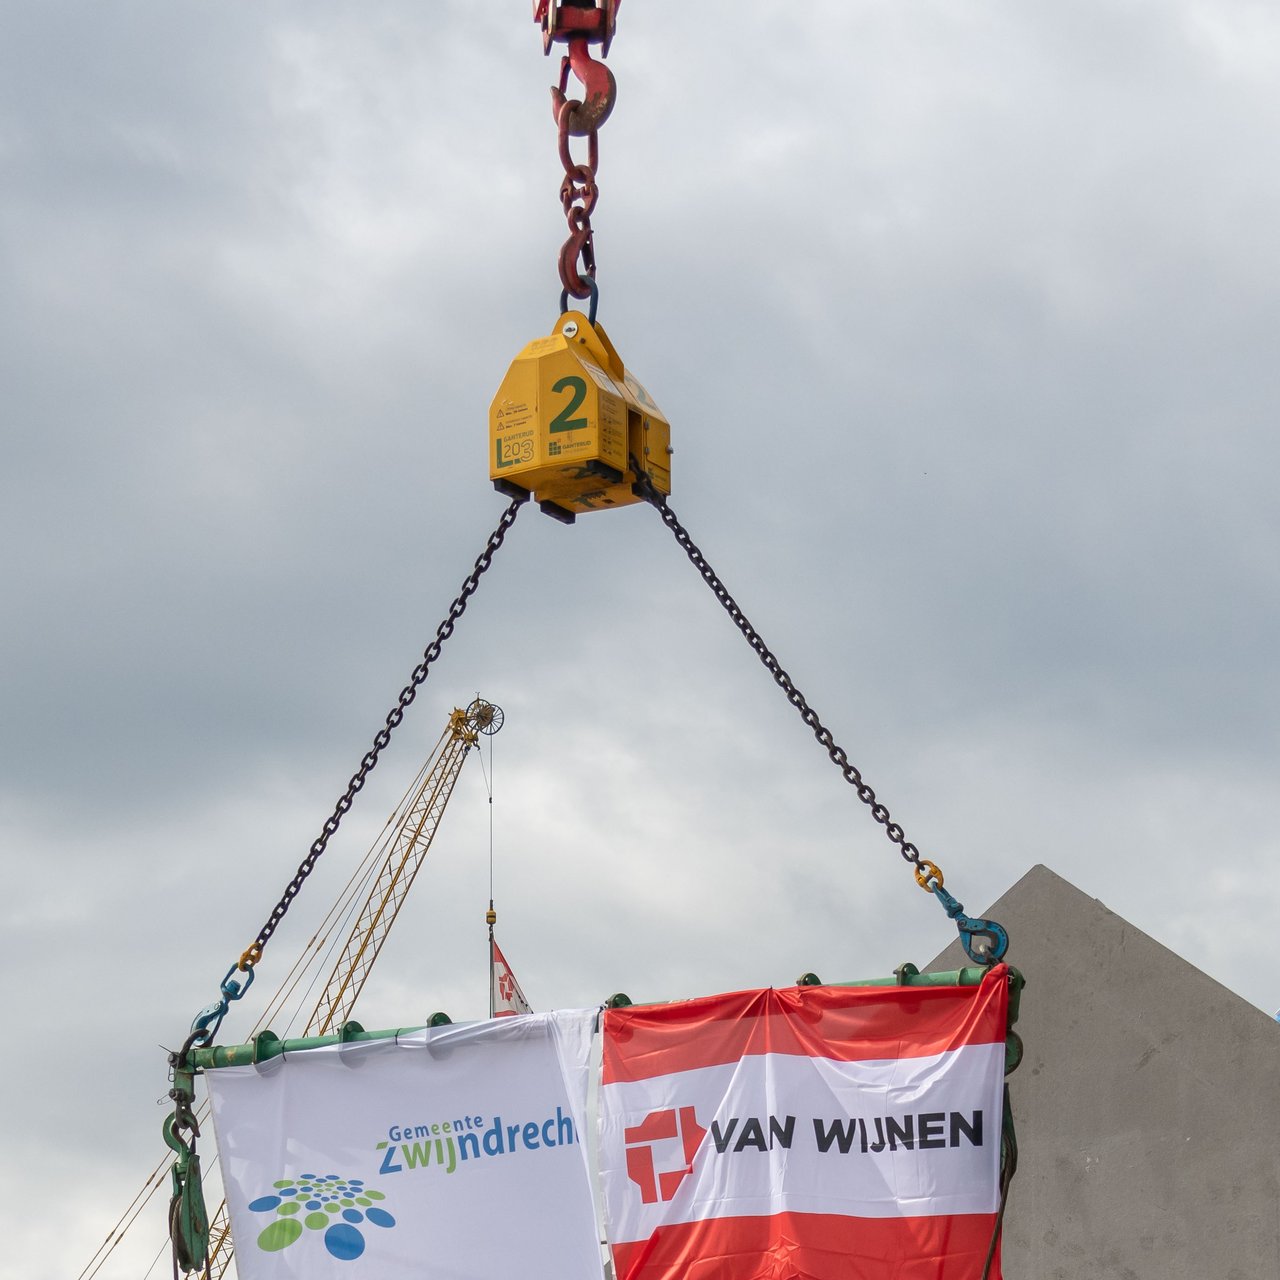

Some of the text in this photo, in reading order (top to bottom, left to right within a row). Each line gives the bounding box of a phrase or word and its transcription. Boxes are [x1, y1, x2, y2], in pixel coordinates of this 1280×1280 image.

[549, 375, 587, 434] 2
[375, 1106, 580, 1175] Zwijndrech
[389, 1115, 483, 1142] Gemeente
[711, 1109, 983, 1154] VAN WIJNEN
